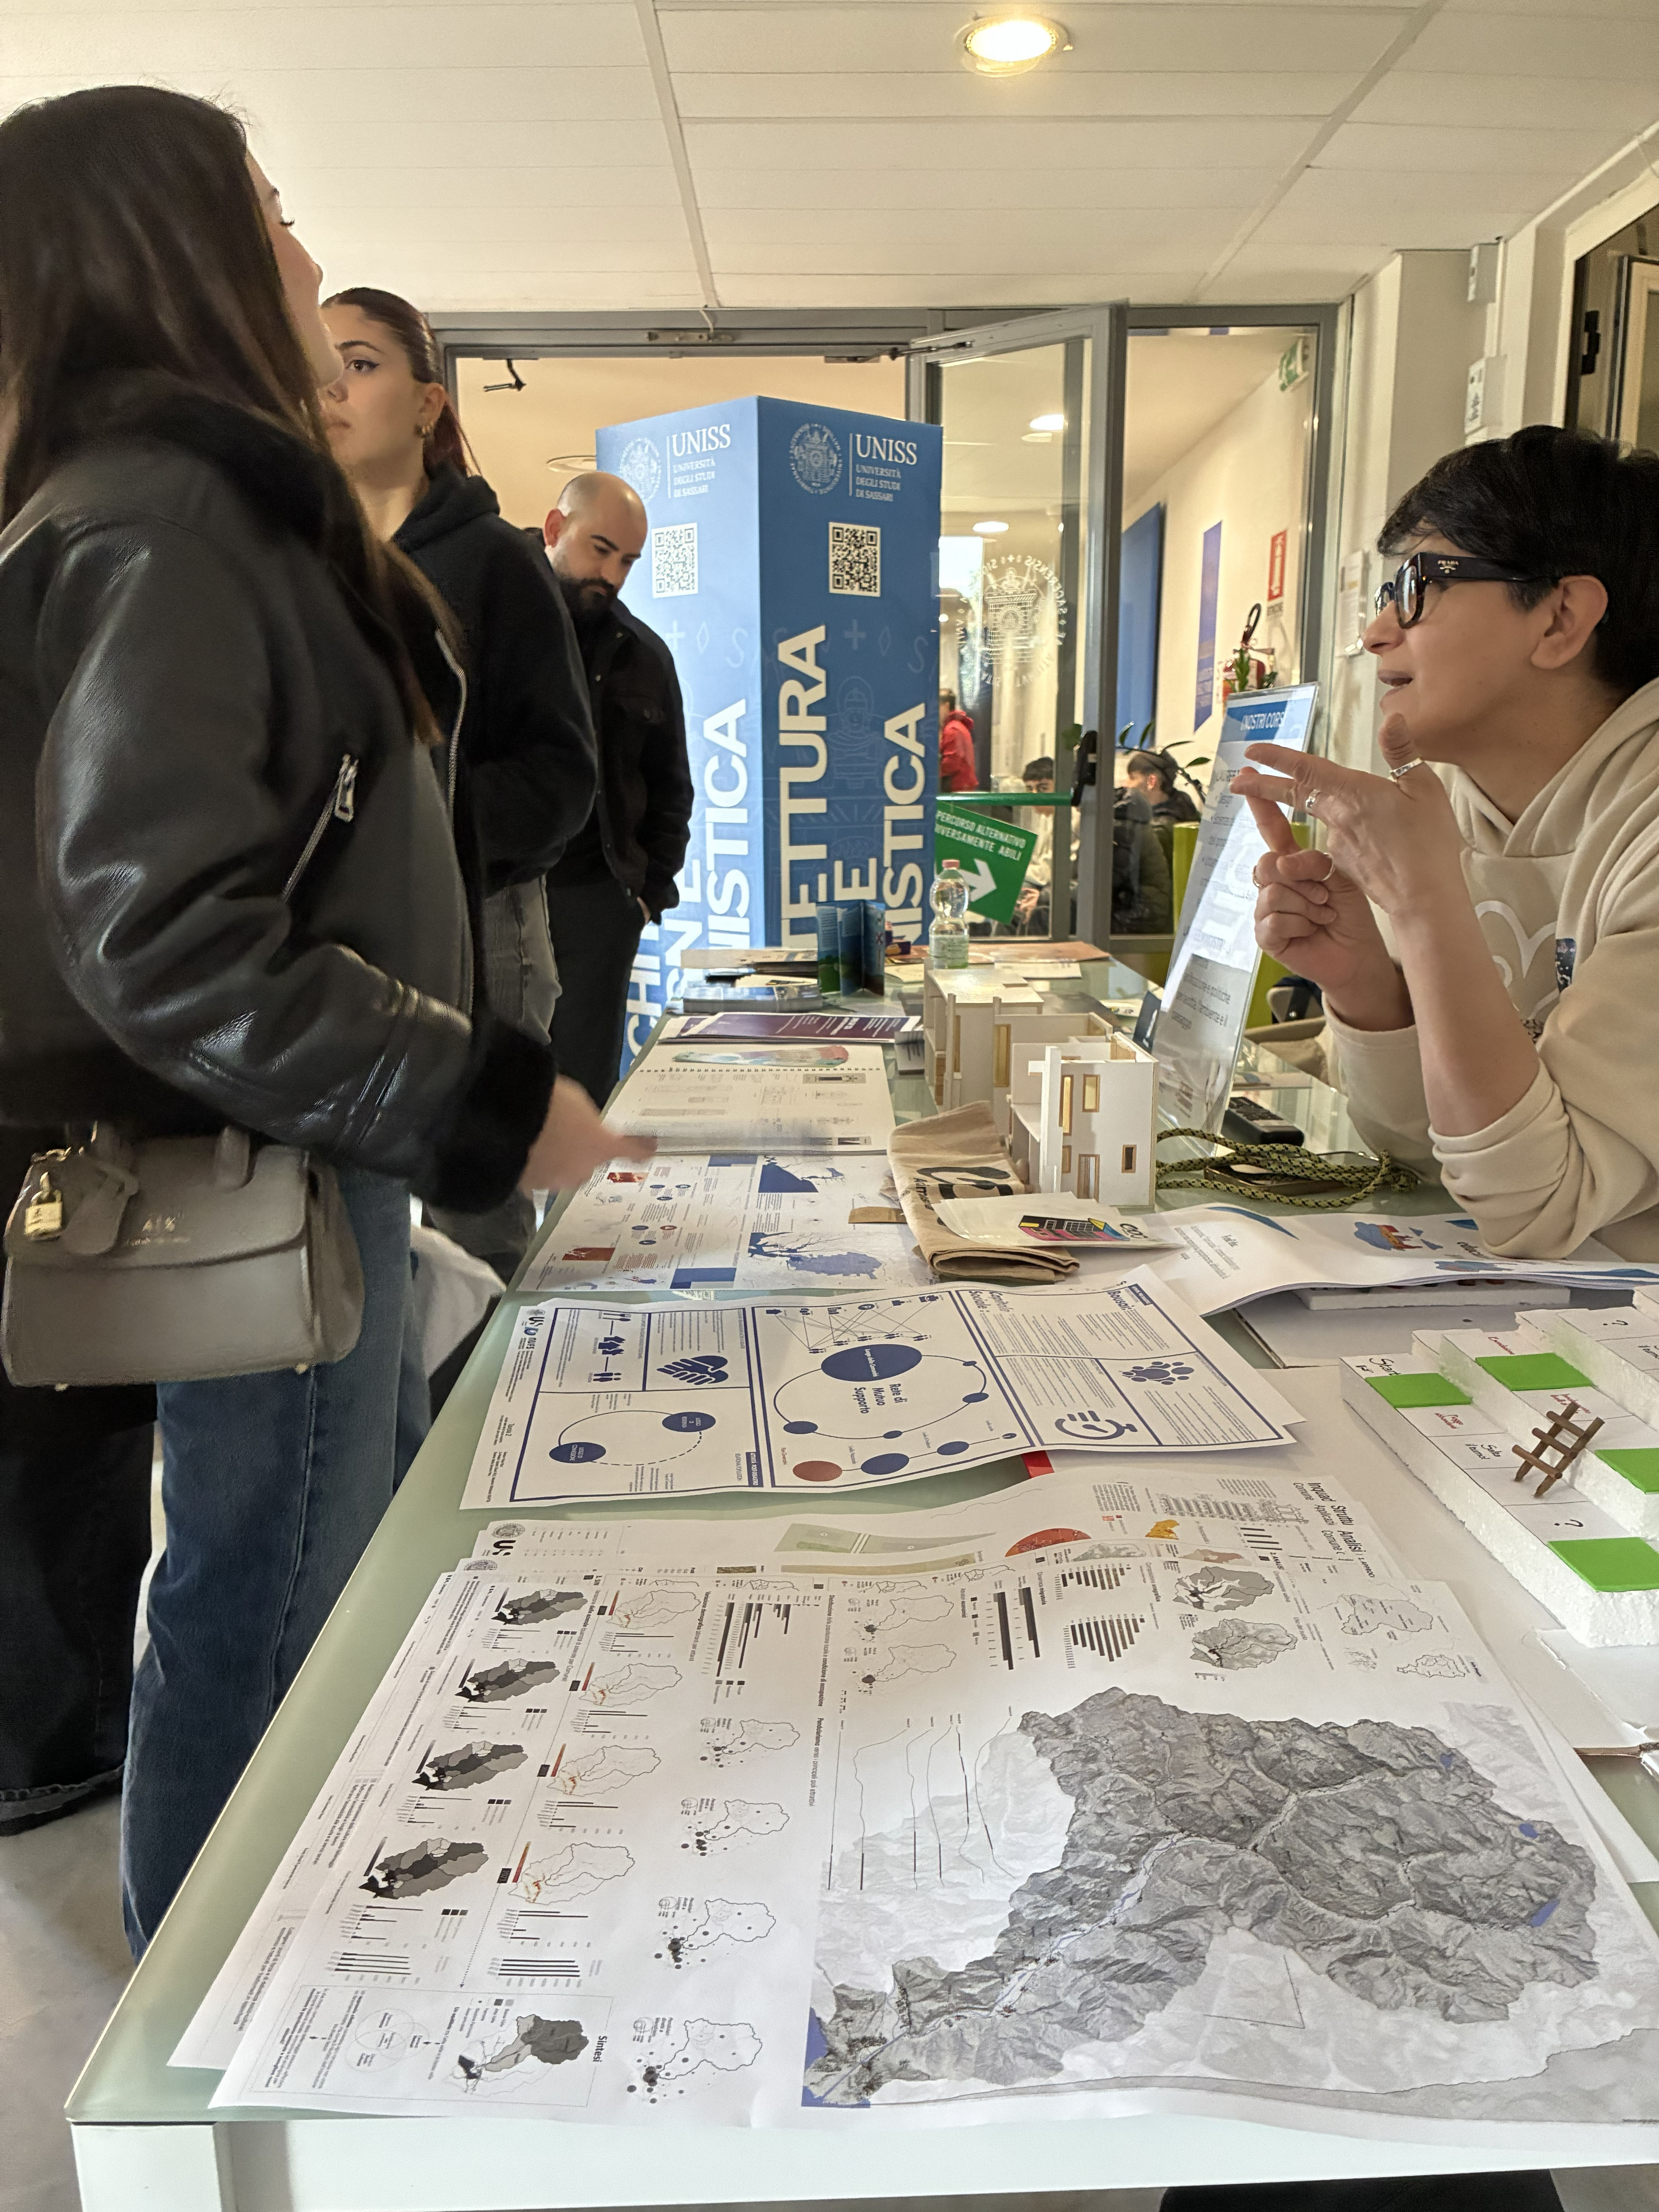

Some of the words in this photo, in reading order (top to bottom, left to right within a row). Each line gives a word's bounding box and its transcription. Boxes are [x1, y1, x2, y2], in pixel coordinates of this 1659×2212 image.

[672, 424, 731, 457] UNISS
[855, 434, 917, 465] UNISS
[855, 464, 901, 479] UNIVERSITÀ
[855, 477, 878, 488] DEGLI
[879, 480, 901, 491] STUDI
[855, 489, 864, 498] DI
[936, 810, 976, 832] PERCORSO
[975, 824, 1026, 848] ALTERNATIVO
[998, 845, 1022, 861] ABILI
[834, 857, 877, 900] E
[969, 1291, 991, 1309] Sociale
[1369, 1358, 1401, 1376] Start
[872, 1388, 885, 1405] Mutuo
[889, 1383, 902, 1396] Rete
[852, 1387, 870, 1413] Supporto
[1308, 1482, 1336, 1501] Inquad
[1554, 1519, 1584, 1530] ?
[1321, 1530, 1342, 1551] Comune
[1337, 1530, 1367, 1552] Analisi
[696, 1608, 707, 1630] demografica
[814, 1718, 824, 1745] Pendolarismo
[592, 2036, 608, 2062] Sintesi
